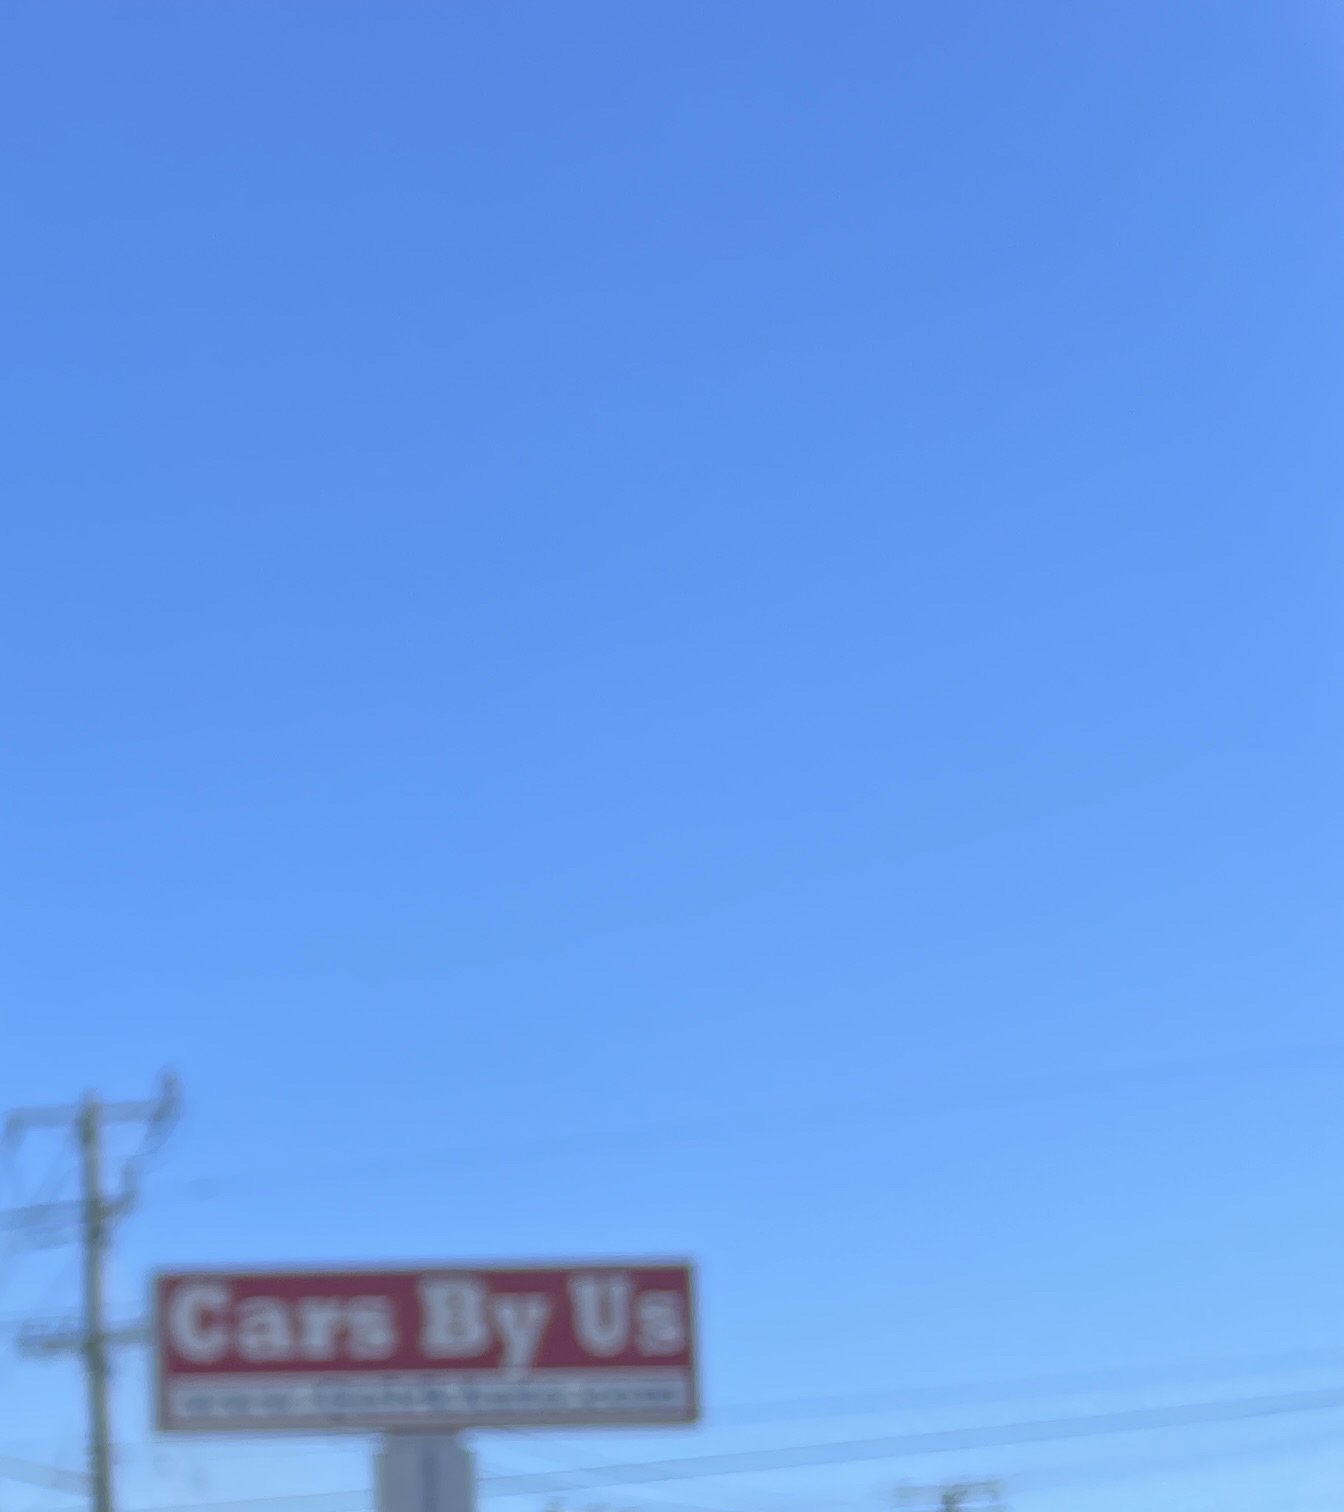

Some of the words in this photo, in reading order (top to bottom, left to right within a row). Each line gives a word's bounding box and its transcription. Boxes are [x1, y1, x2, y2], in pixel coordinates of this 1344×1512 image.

[168, 1280, 395, 1362] Cars
[419, 1275, 551, 1377] By
[568, 1270, 685, 1357] Us
